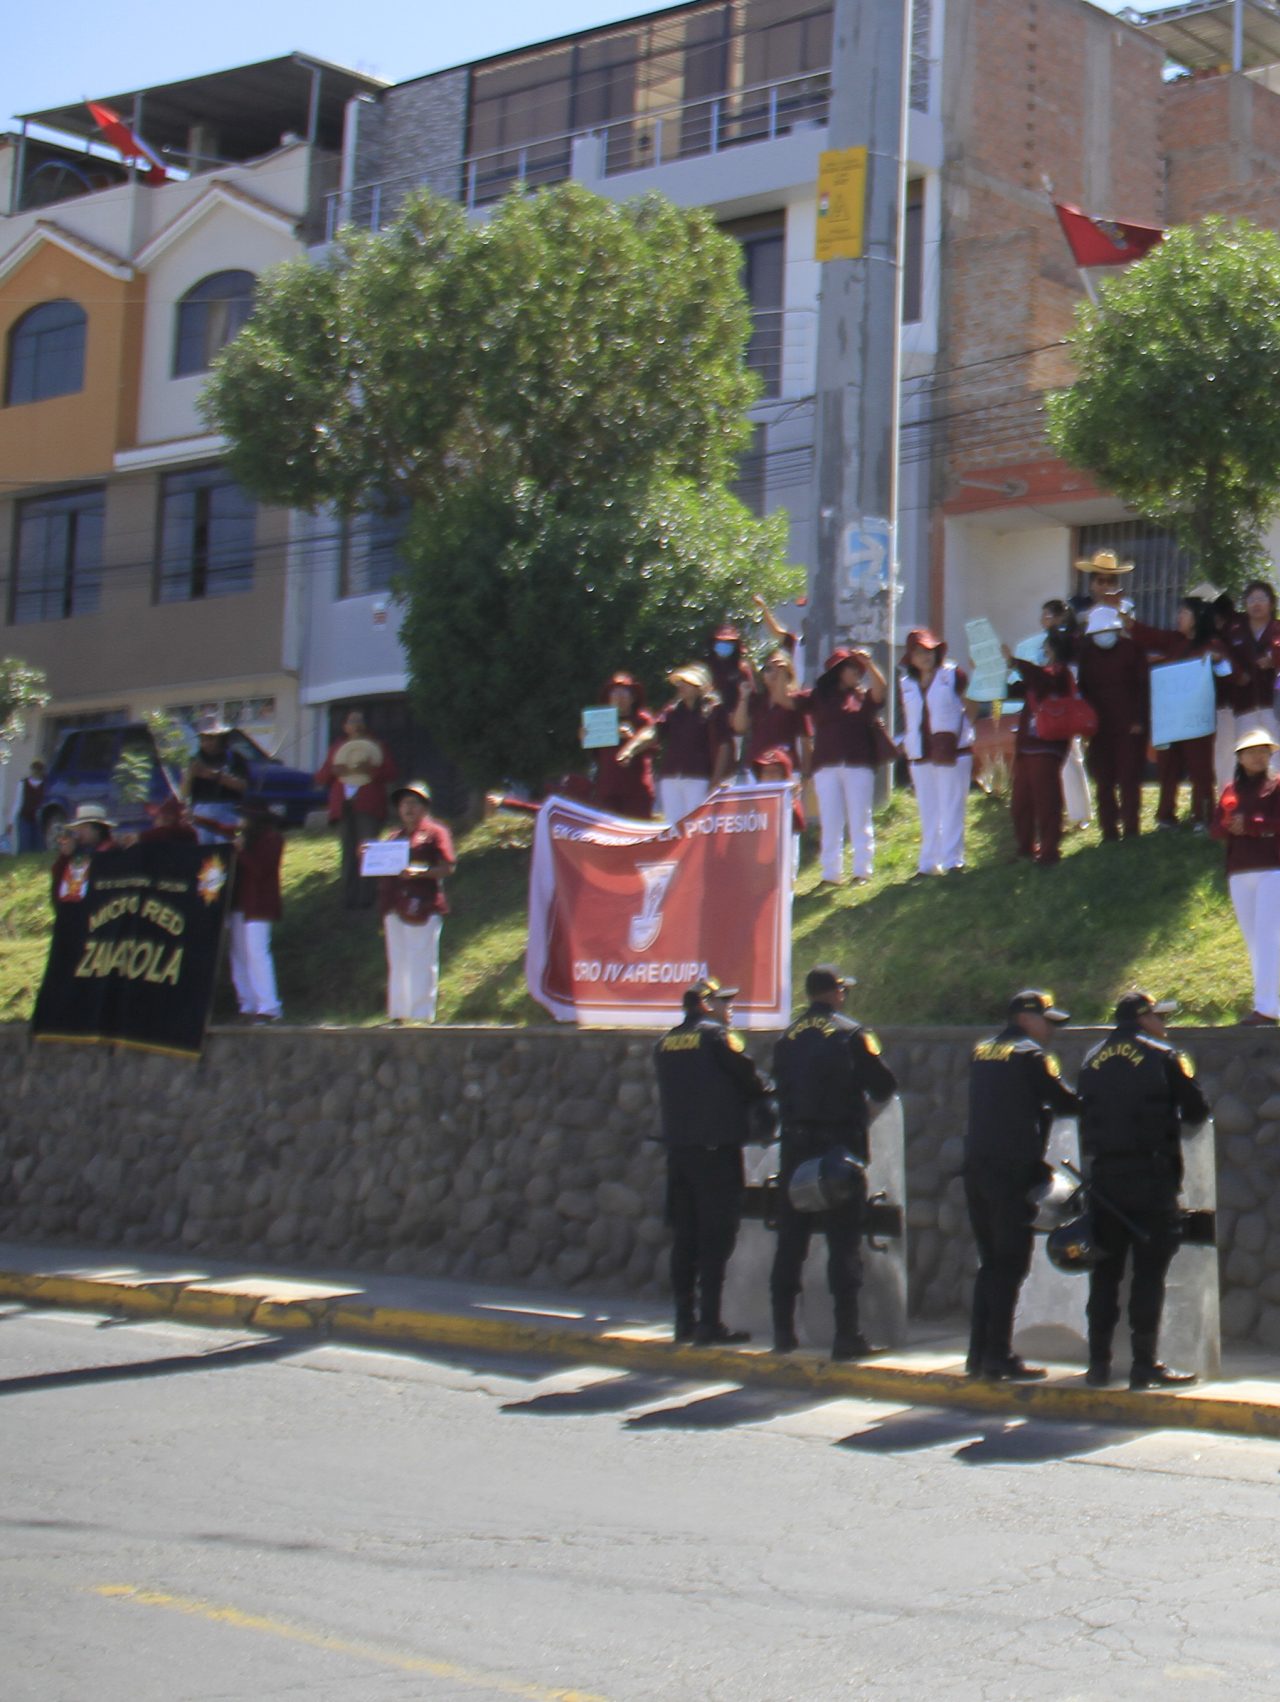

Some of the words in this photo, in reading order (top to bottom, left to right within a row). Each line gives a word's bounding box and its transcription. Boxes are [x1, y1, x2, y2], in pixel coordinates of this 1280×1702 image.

[141, 899, 186, 937] RED
[622, 959, 709, 984] AREQUIPA
[1090, 1042, 1146, 1070] POLICIA
